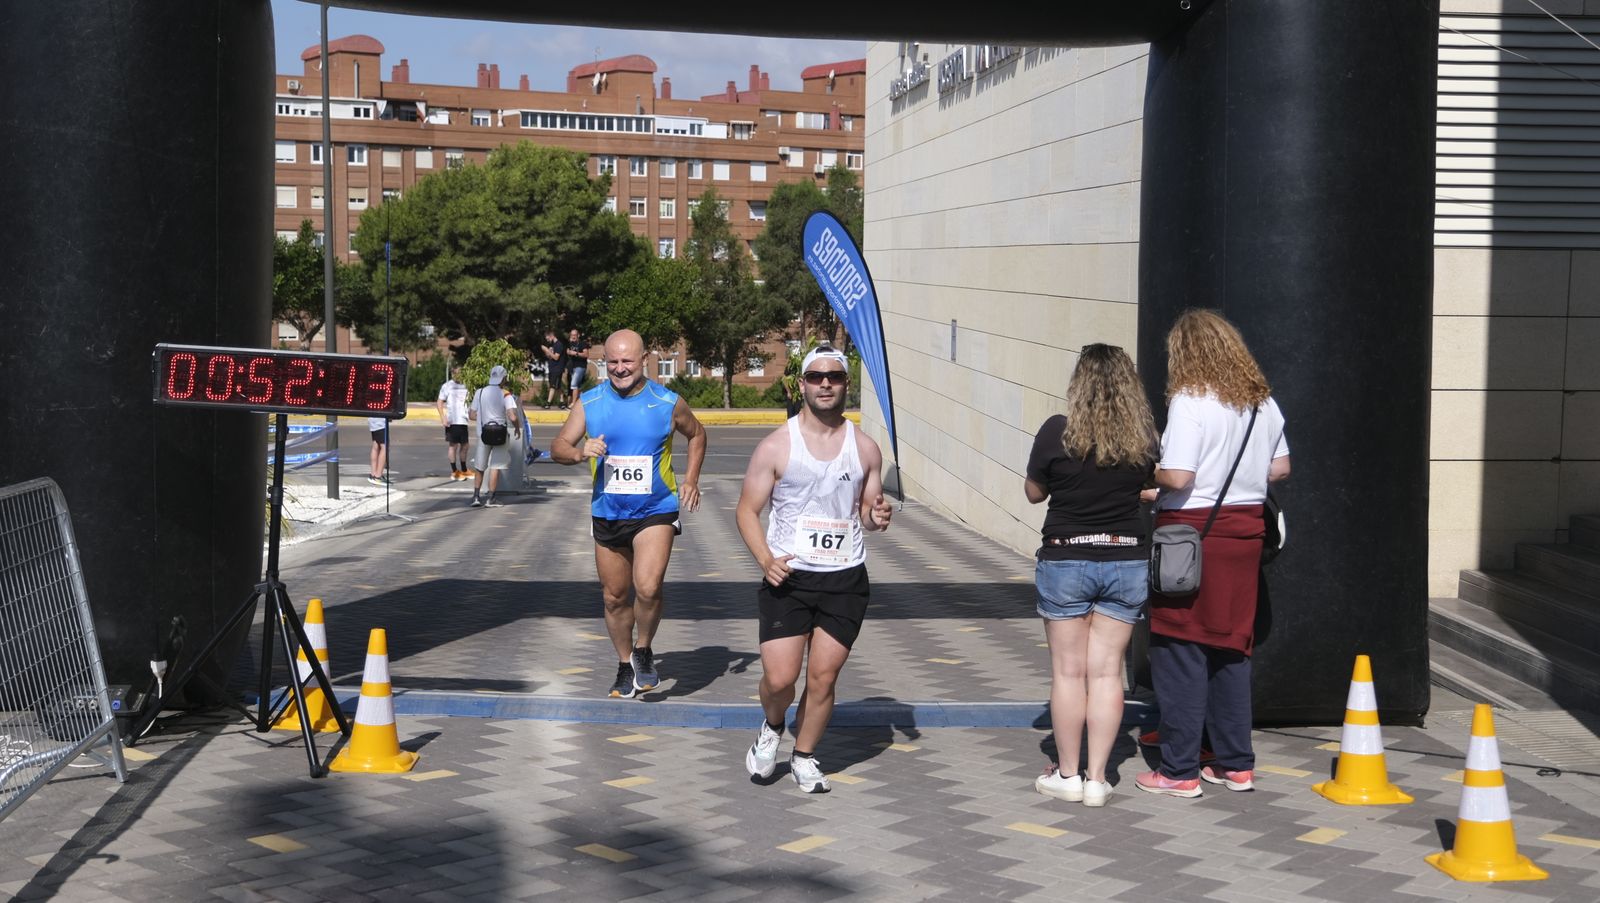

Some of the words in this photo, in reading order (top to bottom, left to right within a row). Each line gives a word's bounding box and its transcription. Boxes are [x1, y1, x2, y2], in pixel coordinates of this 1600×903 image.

[167, 353, 394, 410] 00:52:13
[613, 468, 644, 481] 166
[809, 532, 845, 550] 167
